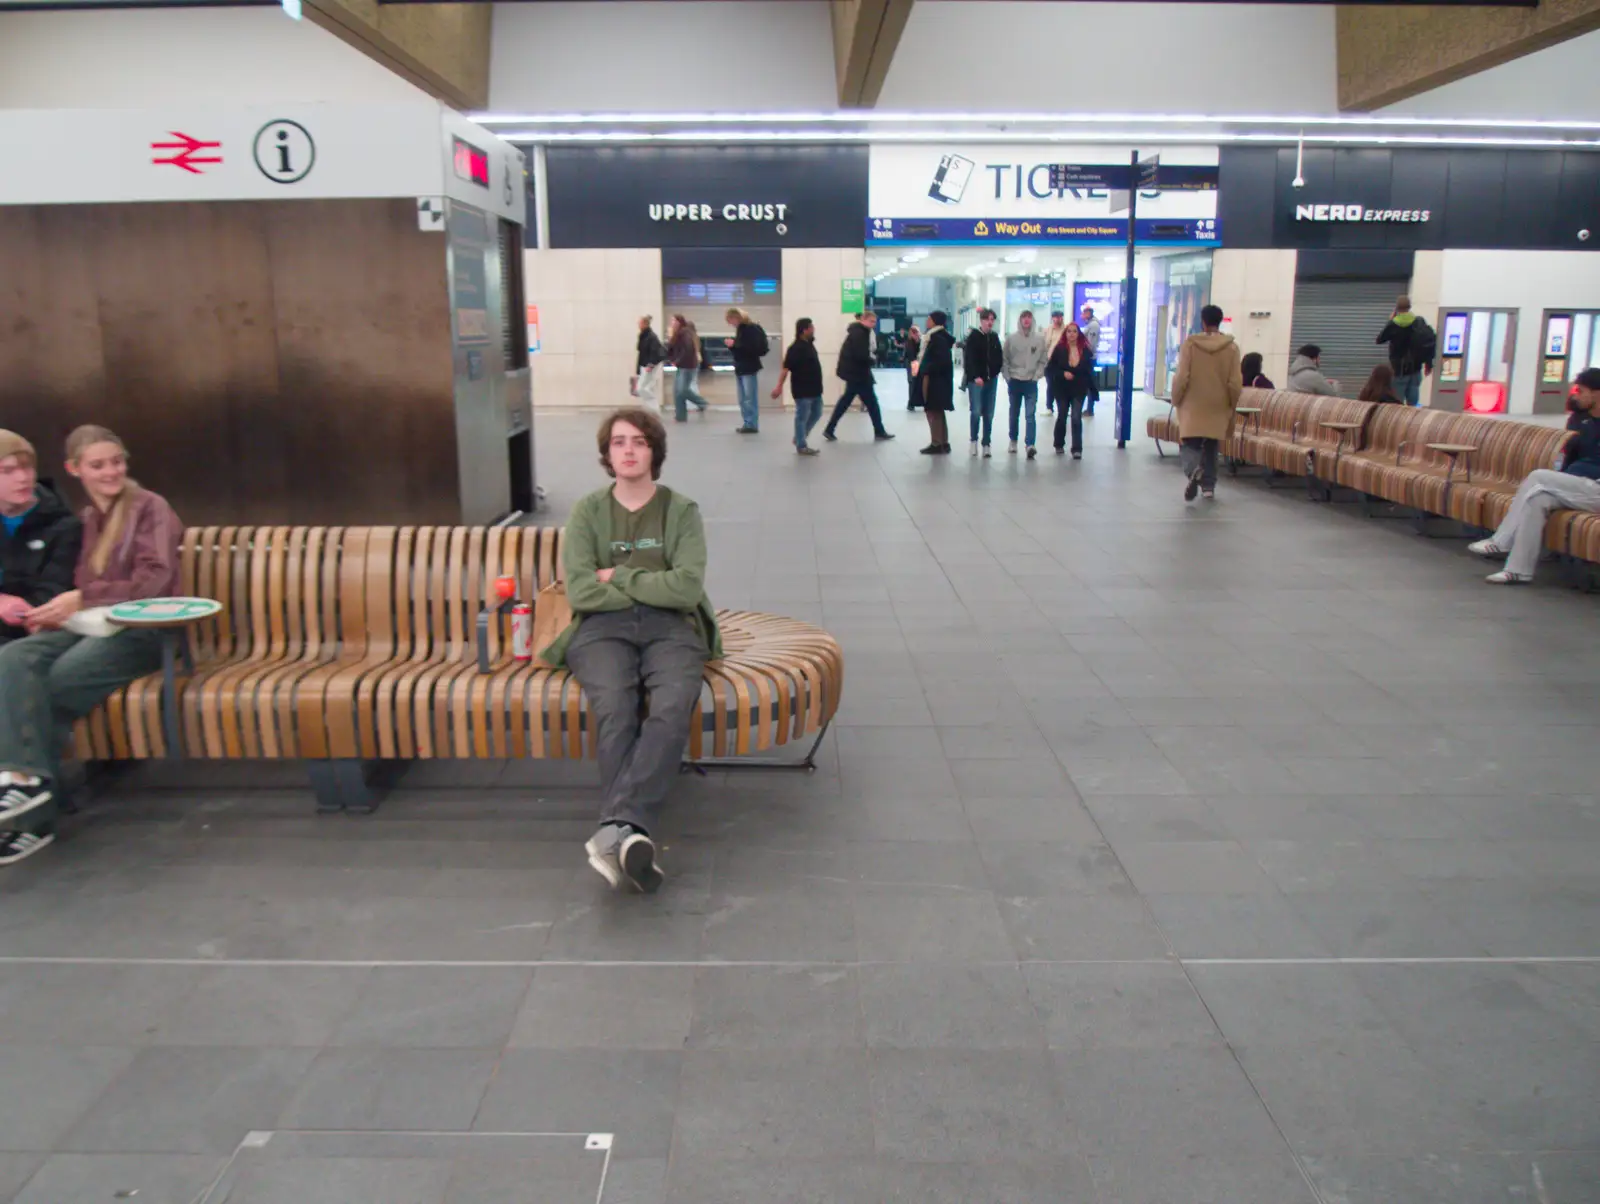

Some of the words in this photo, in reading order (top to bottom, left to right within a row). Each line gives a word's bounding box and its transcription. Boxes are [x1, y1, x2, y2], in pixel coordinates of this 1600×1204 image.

[649, 204, 713, 221] UPPER
[722, 204, 788, 221] CRUST
[1296, 204, 1362, 221] NERO
[1363, 209, 1431, 222] EXPRESS
[872, 229, 893, 239] Taxis
[995, 222, 1019, 236] Way
[1021, 222, 1042, 234] Out
[1194, 230, 1215, 240] Taxis
